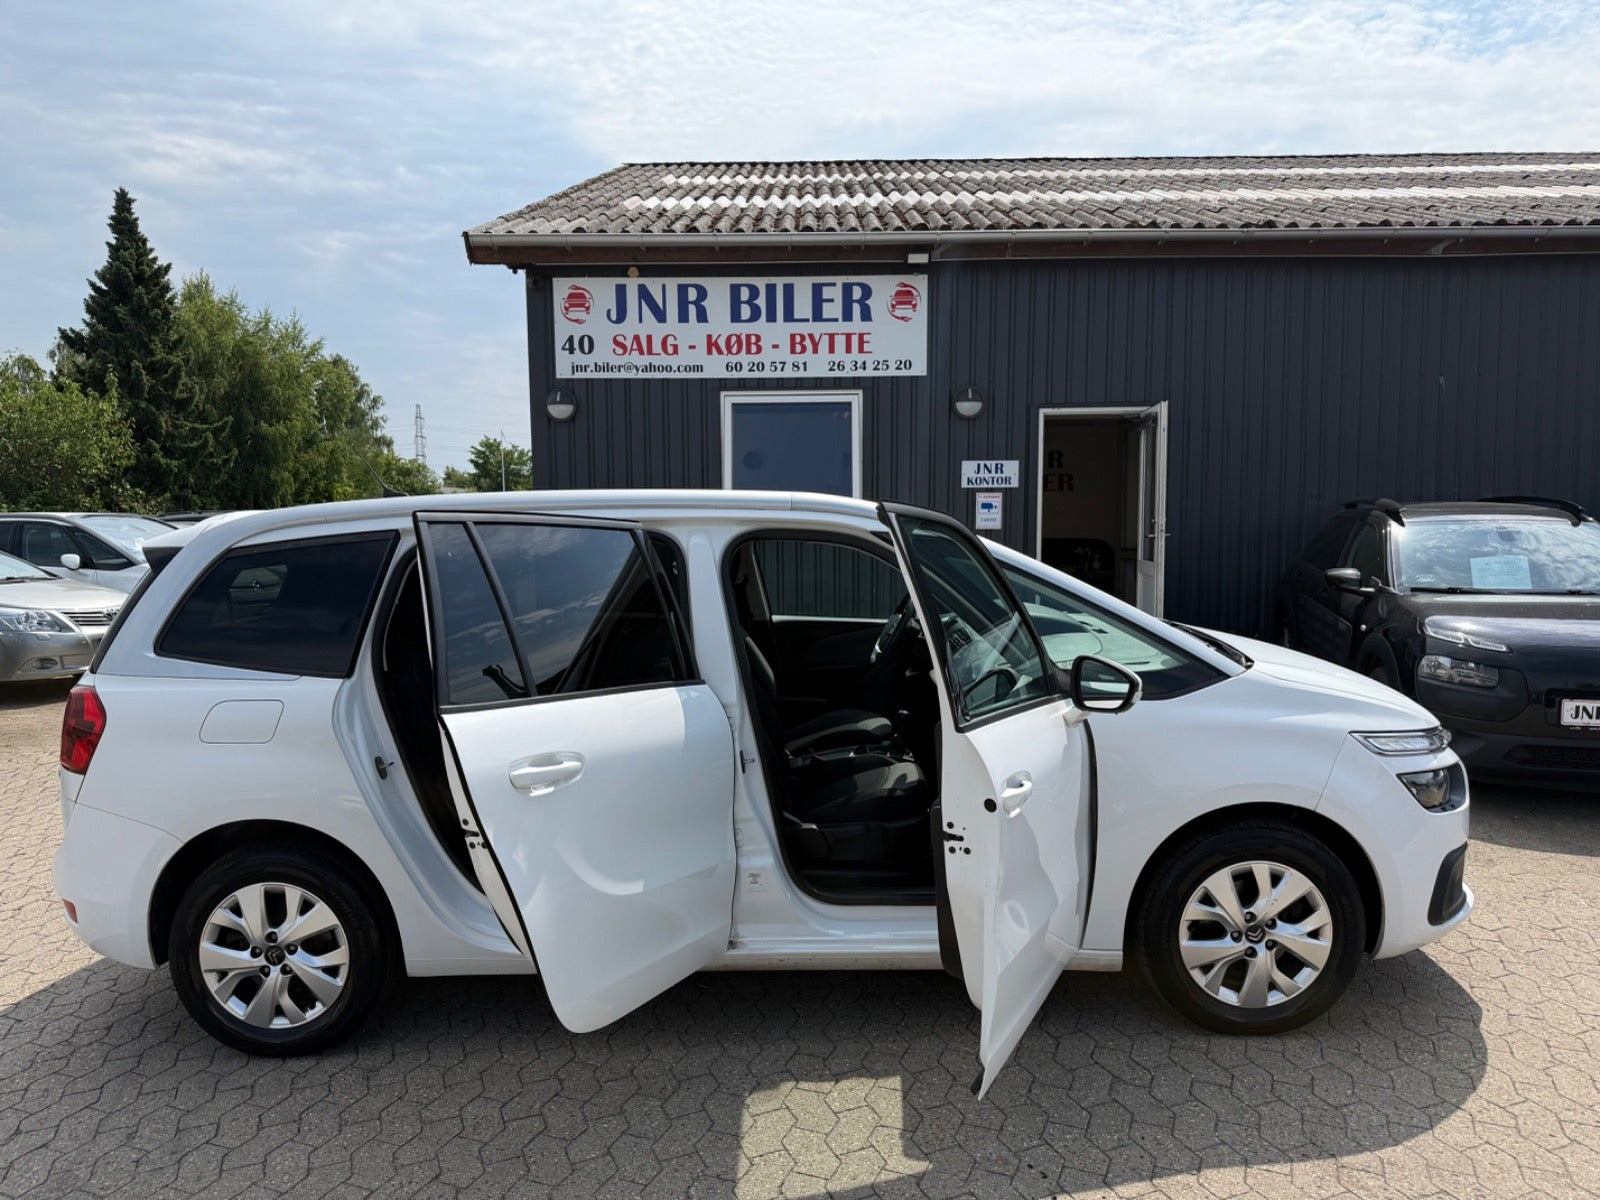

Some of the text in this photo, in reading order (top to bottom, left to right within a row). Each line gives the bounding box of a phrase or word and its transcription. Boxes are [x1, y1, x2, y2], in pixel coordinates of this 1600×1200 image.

[605, 282, 873, 325] JNR BILER
[561, 334, 595, 355] 40
[612, 333, 679, 356] SALG
[706, 332, 763, 356] KØB
[789, 332, 873, 355] BYTTE
[571, 362, 704, 376] jnr.biler@yahoo.com
[725, 361, 808, 373] 60 20 57 81
[828, 359, 912, 372] 26 34 25 20
[974, 462, 1004, 475] JNR
[967, 476, 1012, 486] KONTOR
